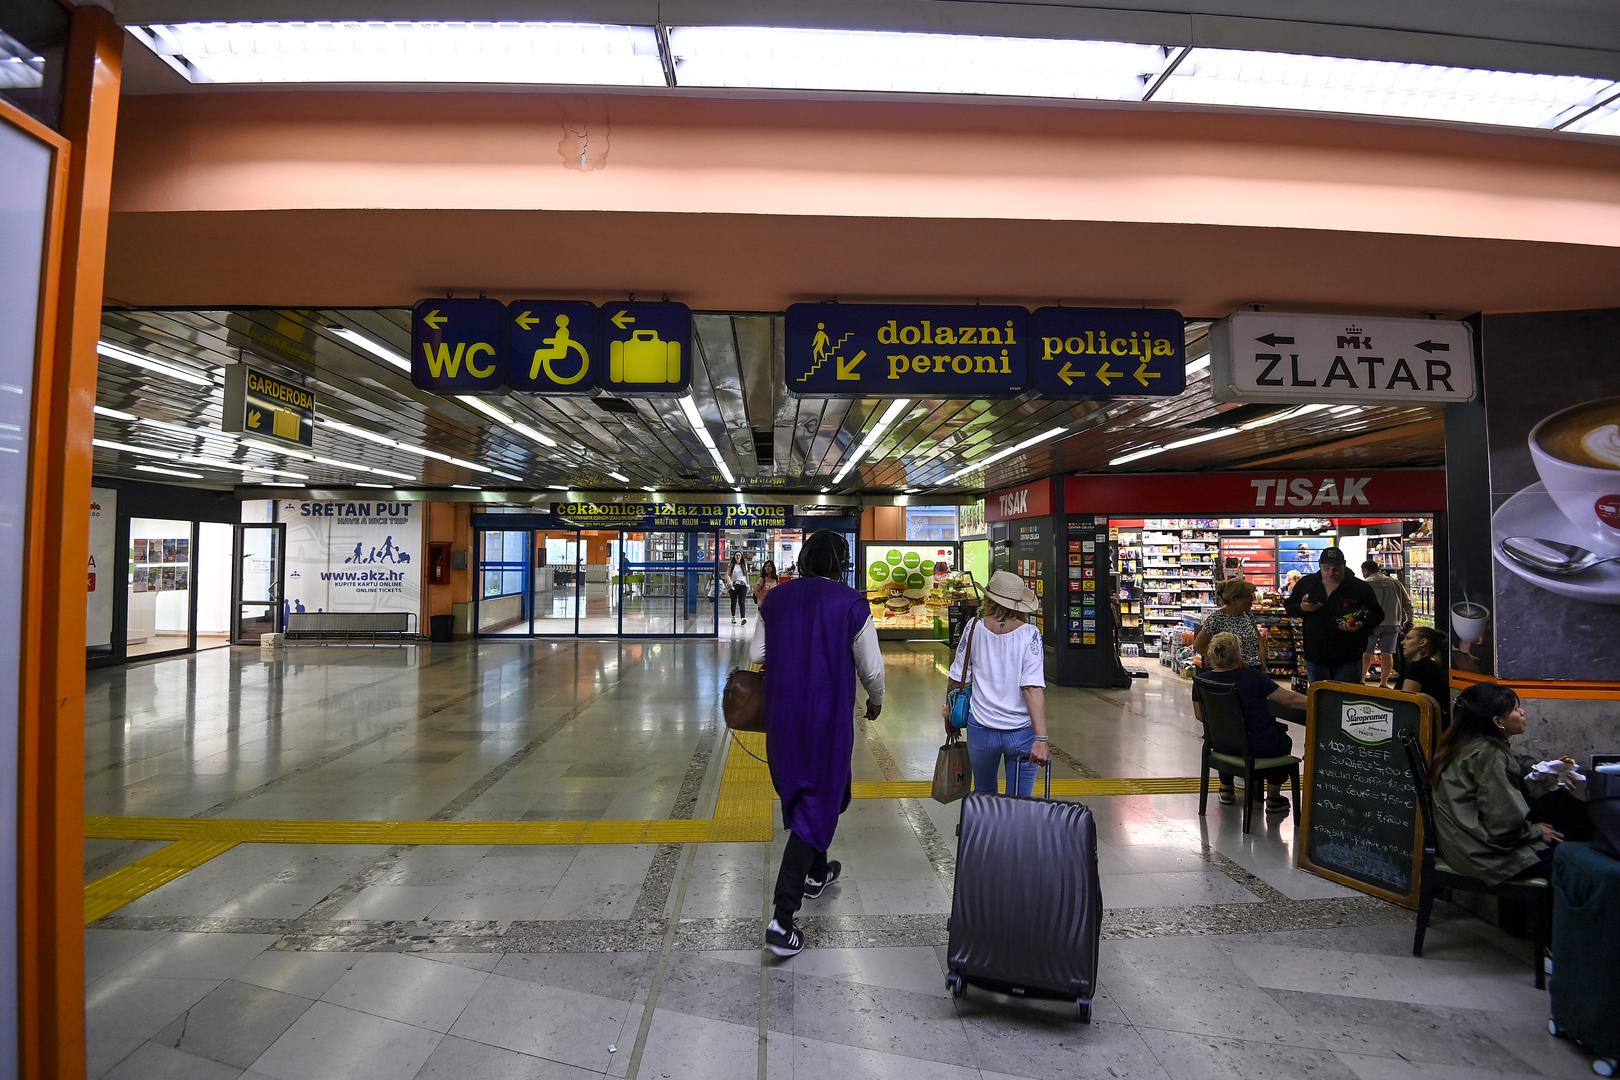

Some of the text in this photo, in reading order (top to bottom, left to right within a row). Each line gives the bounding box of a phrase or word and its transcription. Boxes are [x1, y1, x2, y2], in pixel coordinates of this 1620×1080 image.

[877, 320, 1017, 345] dolazni
[1041, 331, 1175, 363] policija
[423, 342, 497, 379] WC
[887, 349, 1012, 379] peroni
[1254, 353, 1456, 392] ZLATAR
[247, 373, 314, 410] GARDEROBA
[999, 489, 1028, 517] TISAK
[1250, 477, 1373, 507] TISAK
[300, 502, 413, 517] SRETAN PUT
[388, 517, 409, 525] TRIP
[654, 518, 679, 526] WAITING
[682, 518, 699, 526] ROOM
[710, 518, 721, 526] WAY
[724, 518, 736, 526] OUT
[739, 518, 748, 526] ON
[750, 518, 786, 526] PLATFORMS
[702, 506, 723, 516] na
[727, 504, 785, 519] perone
[320, 569, 405, 581] www.akz.hr
[1346, 708, 1388, 725] Staropramen
[1358, 746, 1393, 761] BEEF
